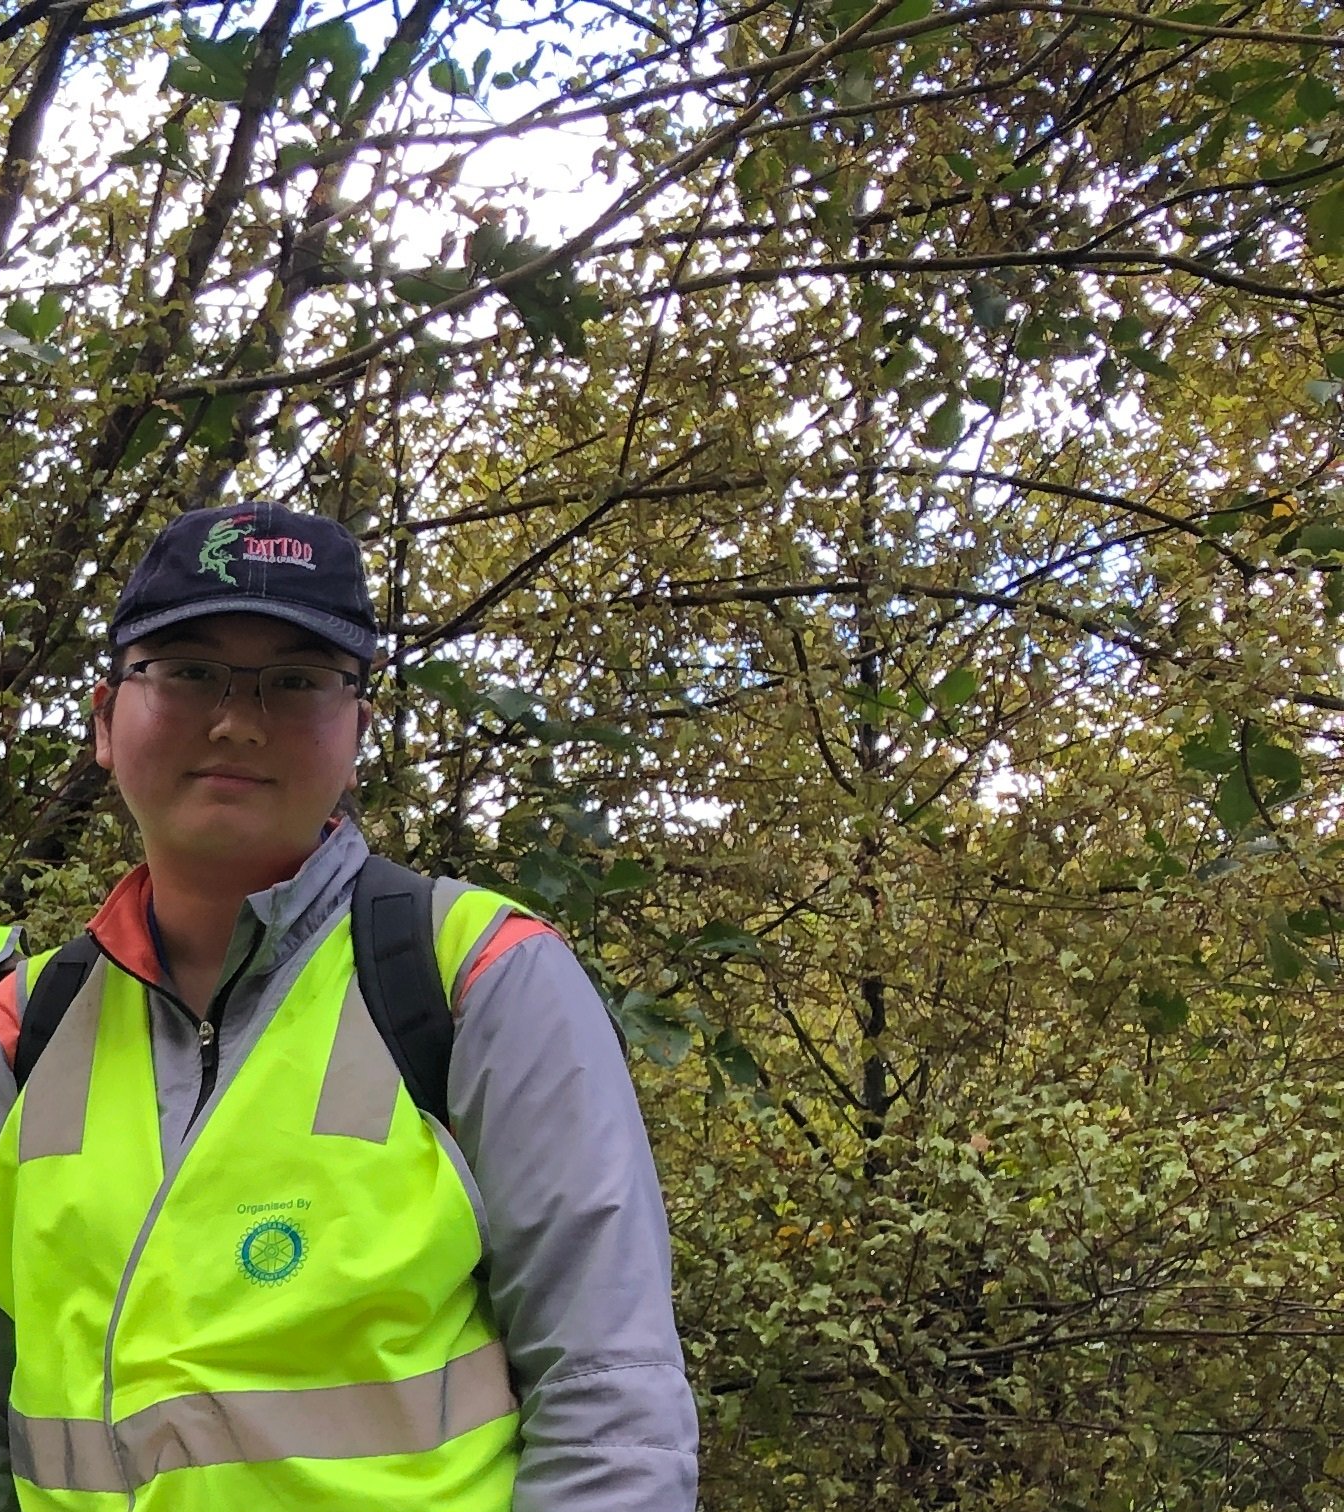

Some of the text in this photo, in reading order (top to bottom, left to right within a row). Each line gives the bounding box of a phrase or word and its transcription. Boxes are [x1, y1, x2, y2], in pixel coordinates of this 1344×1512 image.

[244, 537, 312, 562] TATTOO
[237, 1198, 312, 1215] Organised By
